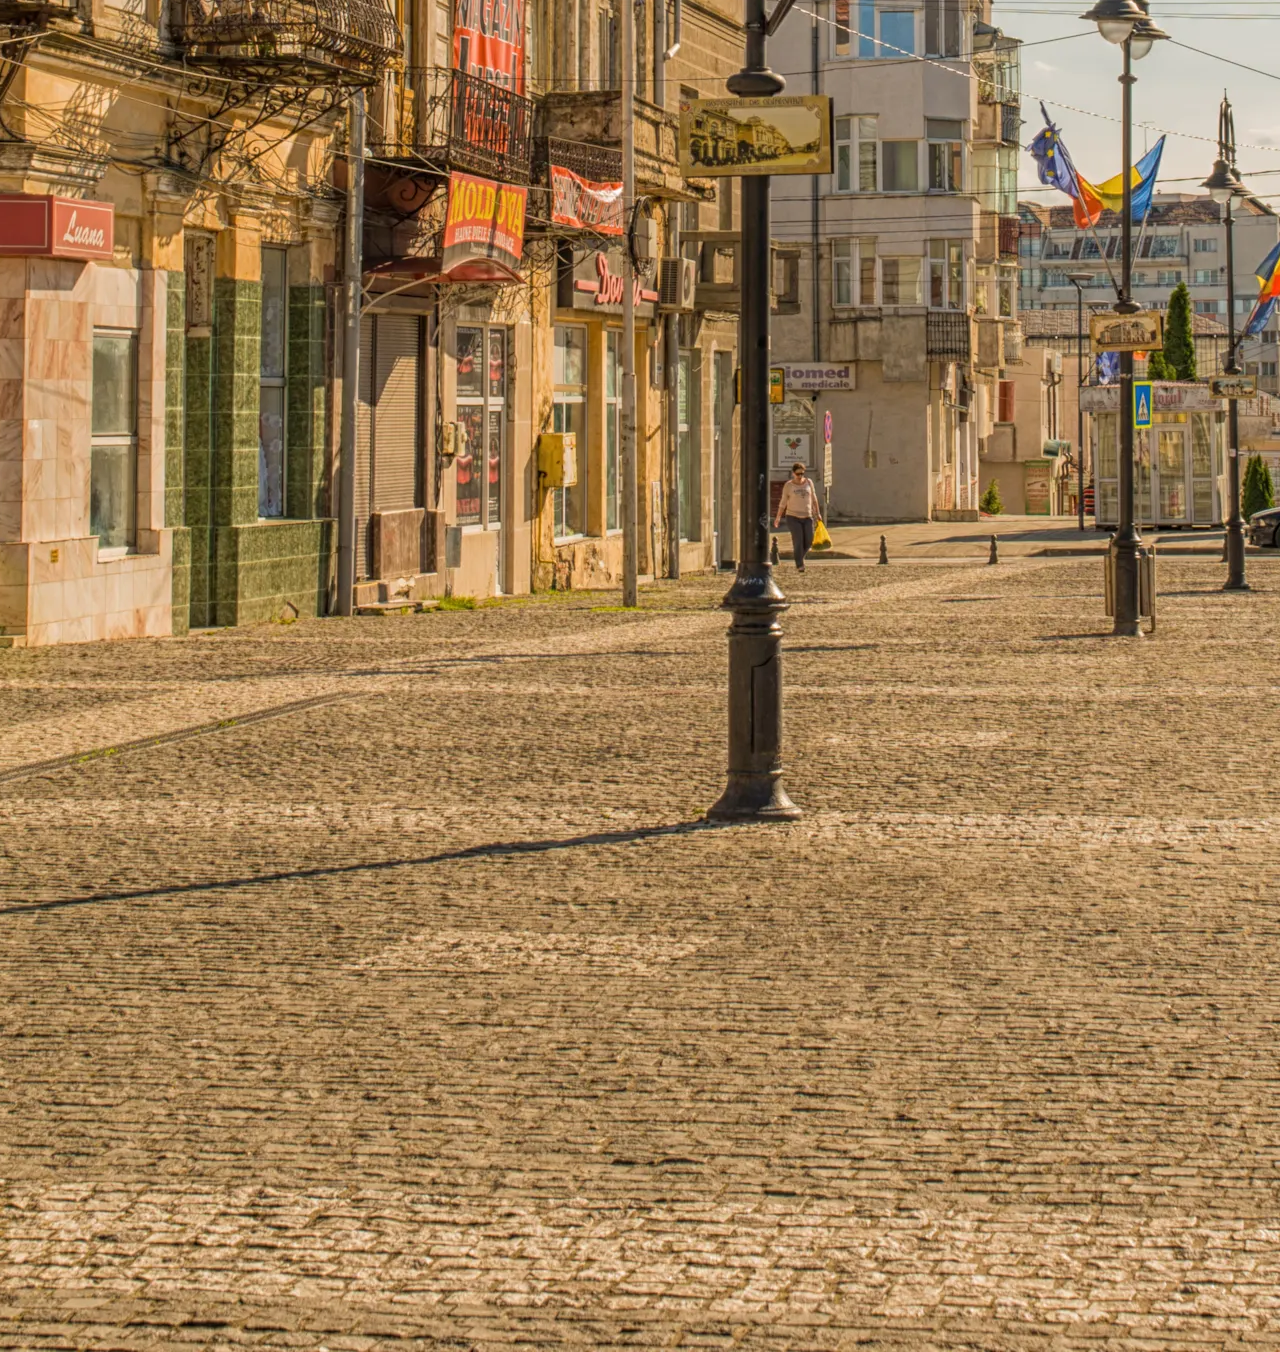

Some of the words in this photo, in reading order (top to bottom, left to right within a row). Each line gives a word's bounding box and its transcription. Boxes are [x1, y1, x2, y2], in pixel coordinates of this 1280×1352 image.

[448, 178, 524, 241] MOLDOVA
[63, 210, 105, 248] Luana
[785, 366, 850, 379] iomed
[801, 380, 850, 388] medicale
